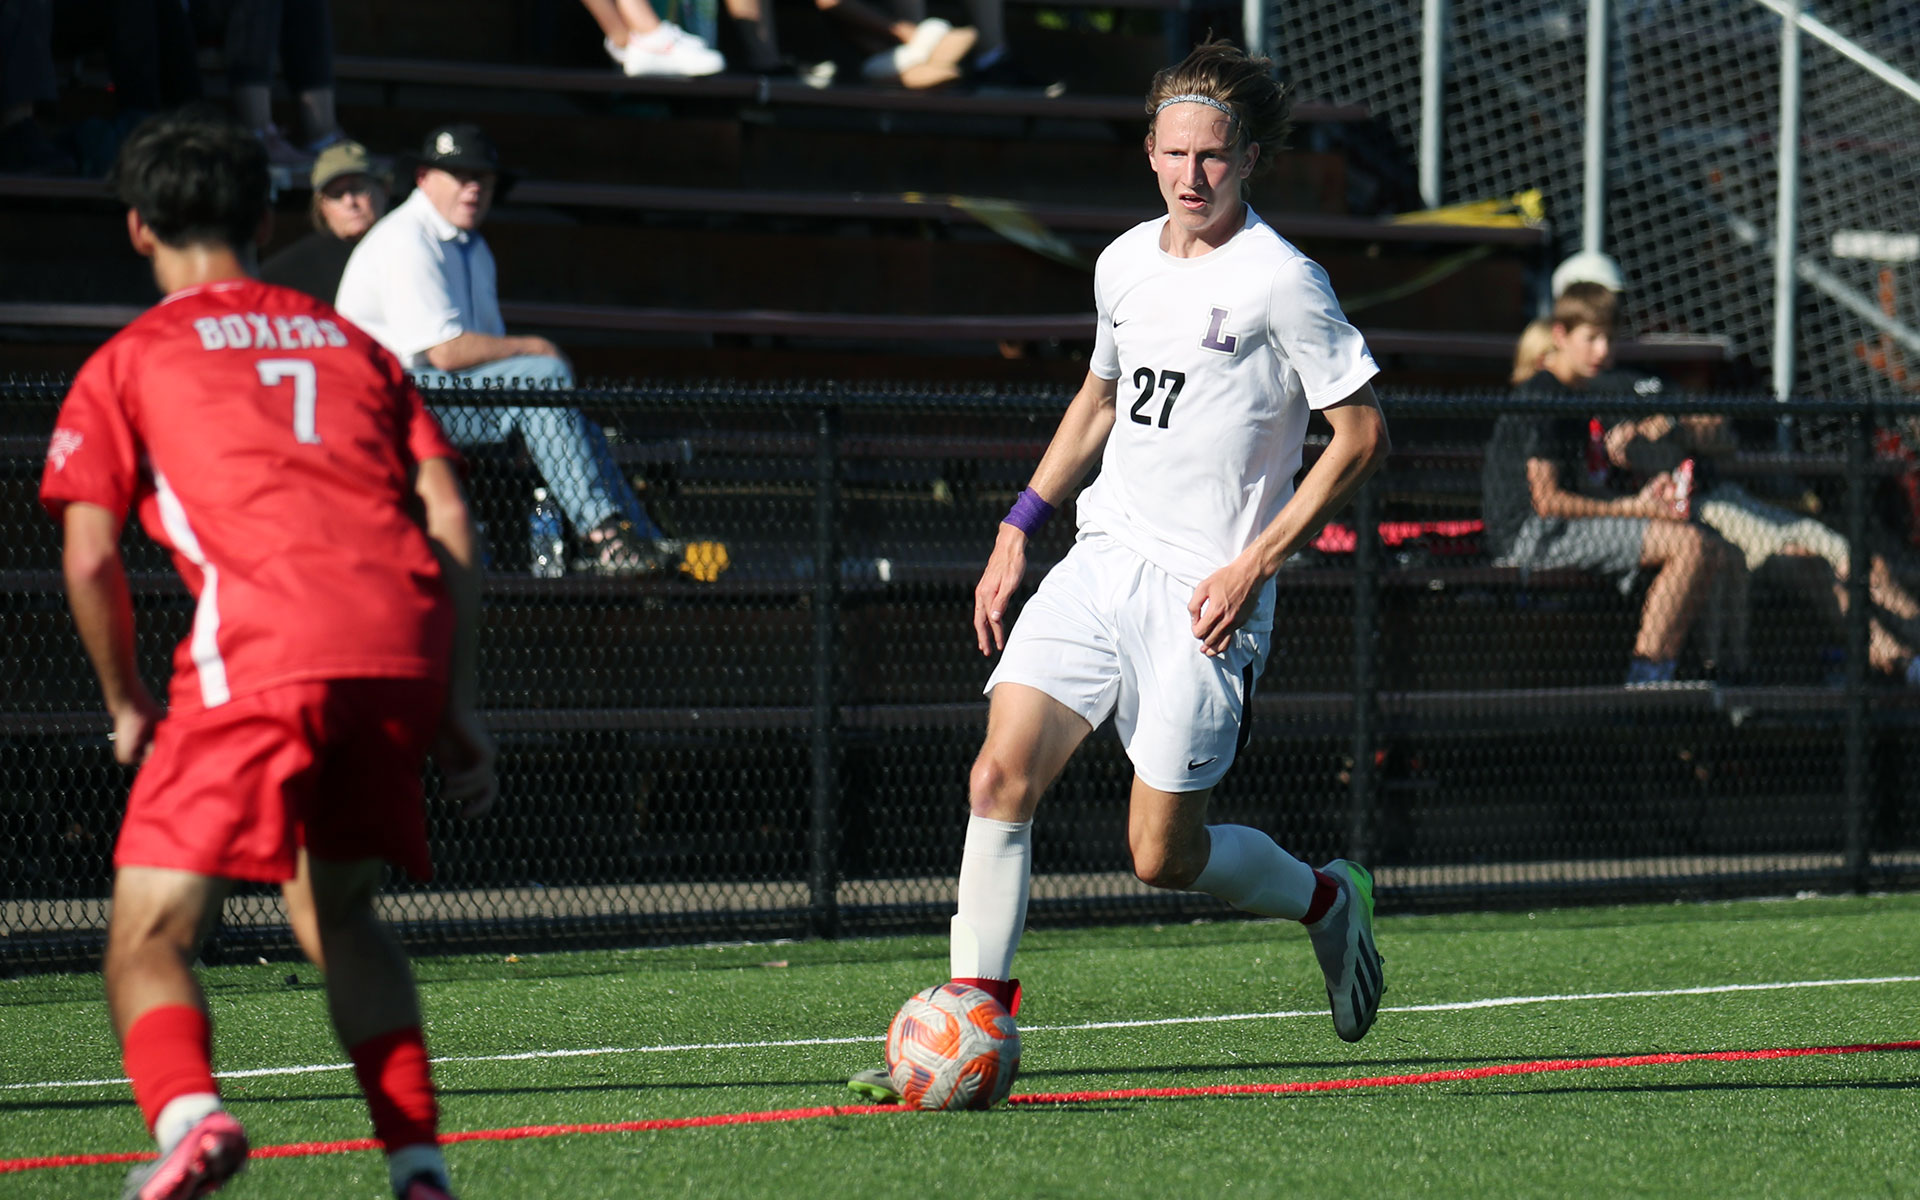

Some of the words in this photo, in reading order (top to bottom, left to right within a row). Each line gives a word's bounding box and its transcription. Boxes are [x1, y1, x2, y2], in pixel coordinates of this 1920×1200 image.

[194, 312, 348, 350] BOXERS
[1200, 305, 1239, 356] L
[255, 358, 322, 444] 7
[1130, 367, 1186, 429] 27
